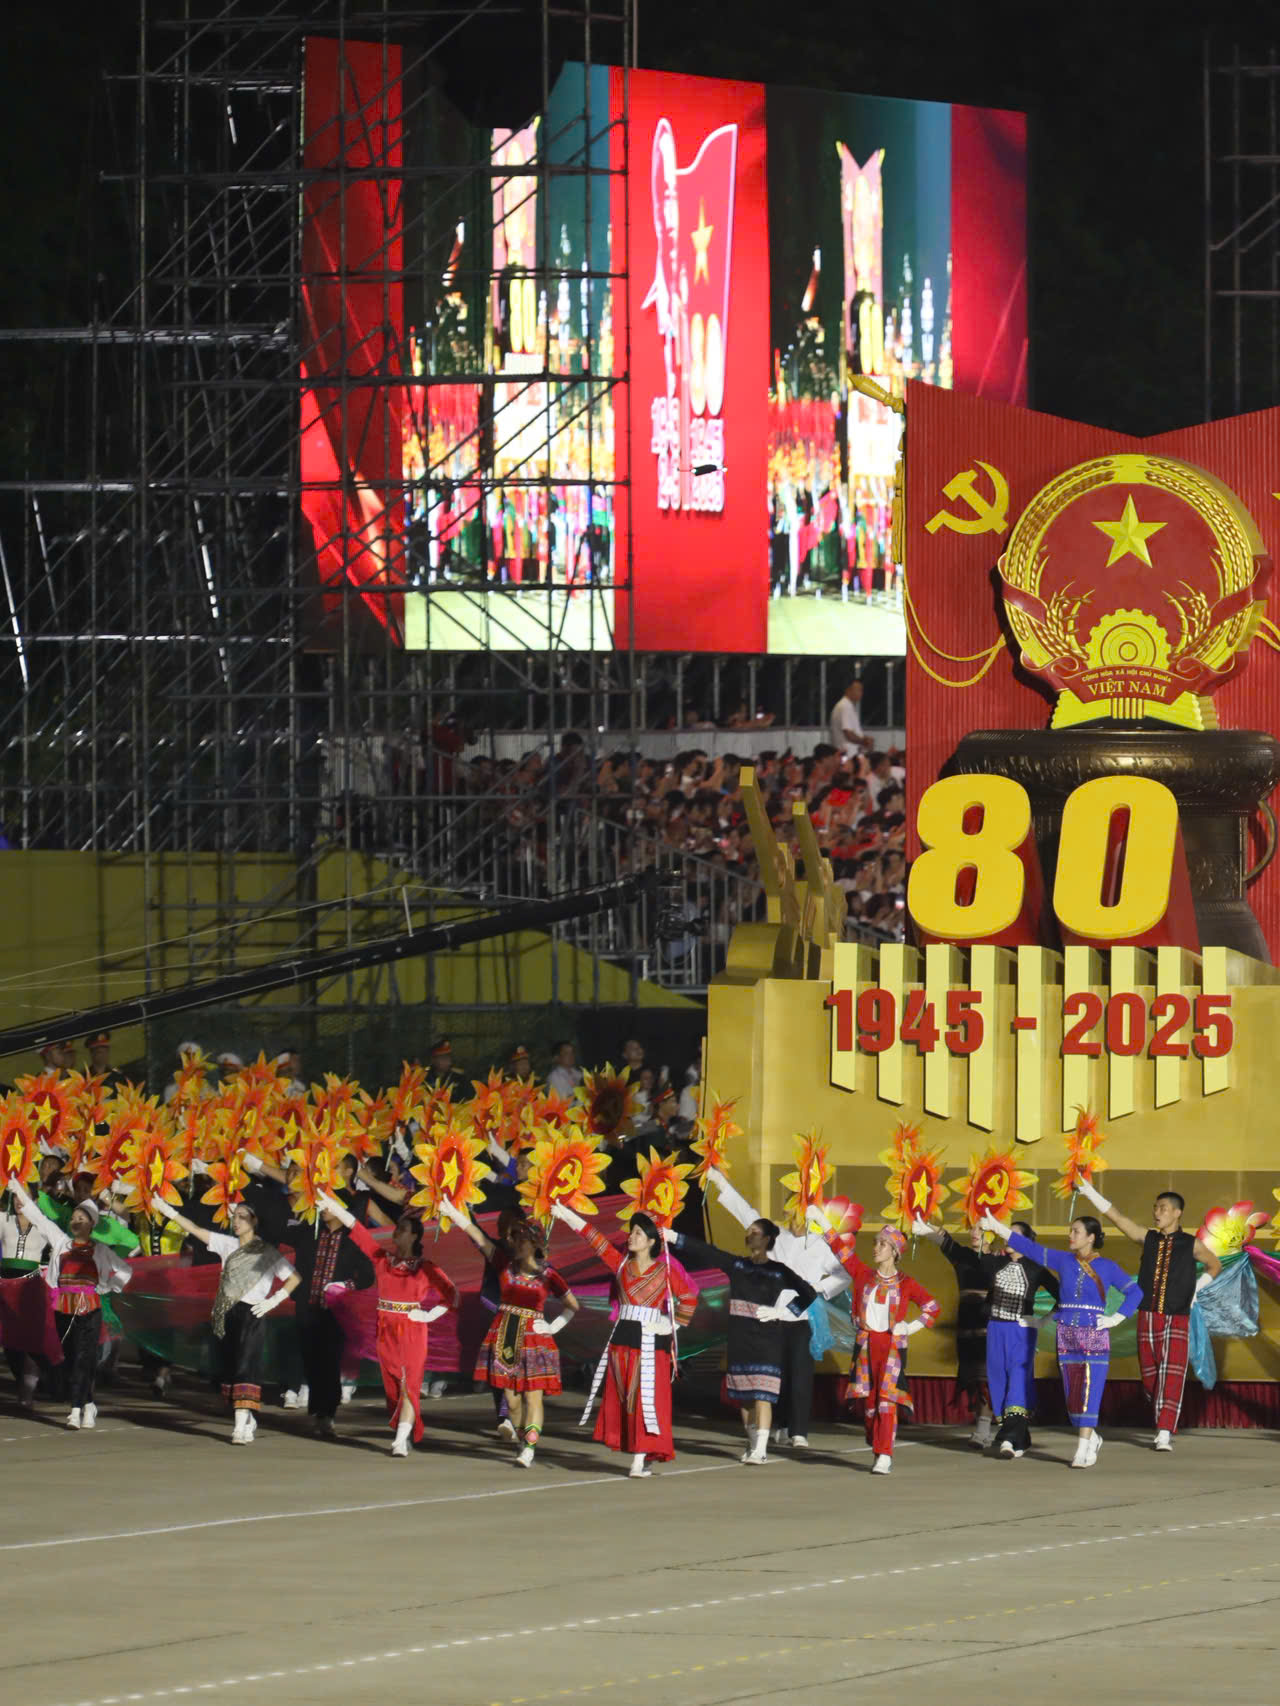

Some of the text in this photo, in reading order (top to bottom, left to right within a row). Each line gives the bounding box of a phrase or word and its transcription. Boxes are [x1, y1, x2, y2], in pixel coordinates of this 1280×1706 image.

[1087, 678, 1167, 698] VIỆT NAM
[907, 773, 1179, 940] 80
[826, 988, 984, 1054] 1945
[1061, 992, 1234, 1058] 2025
